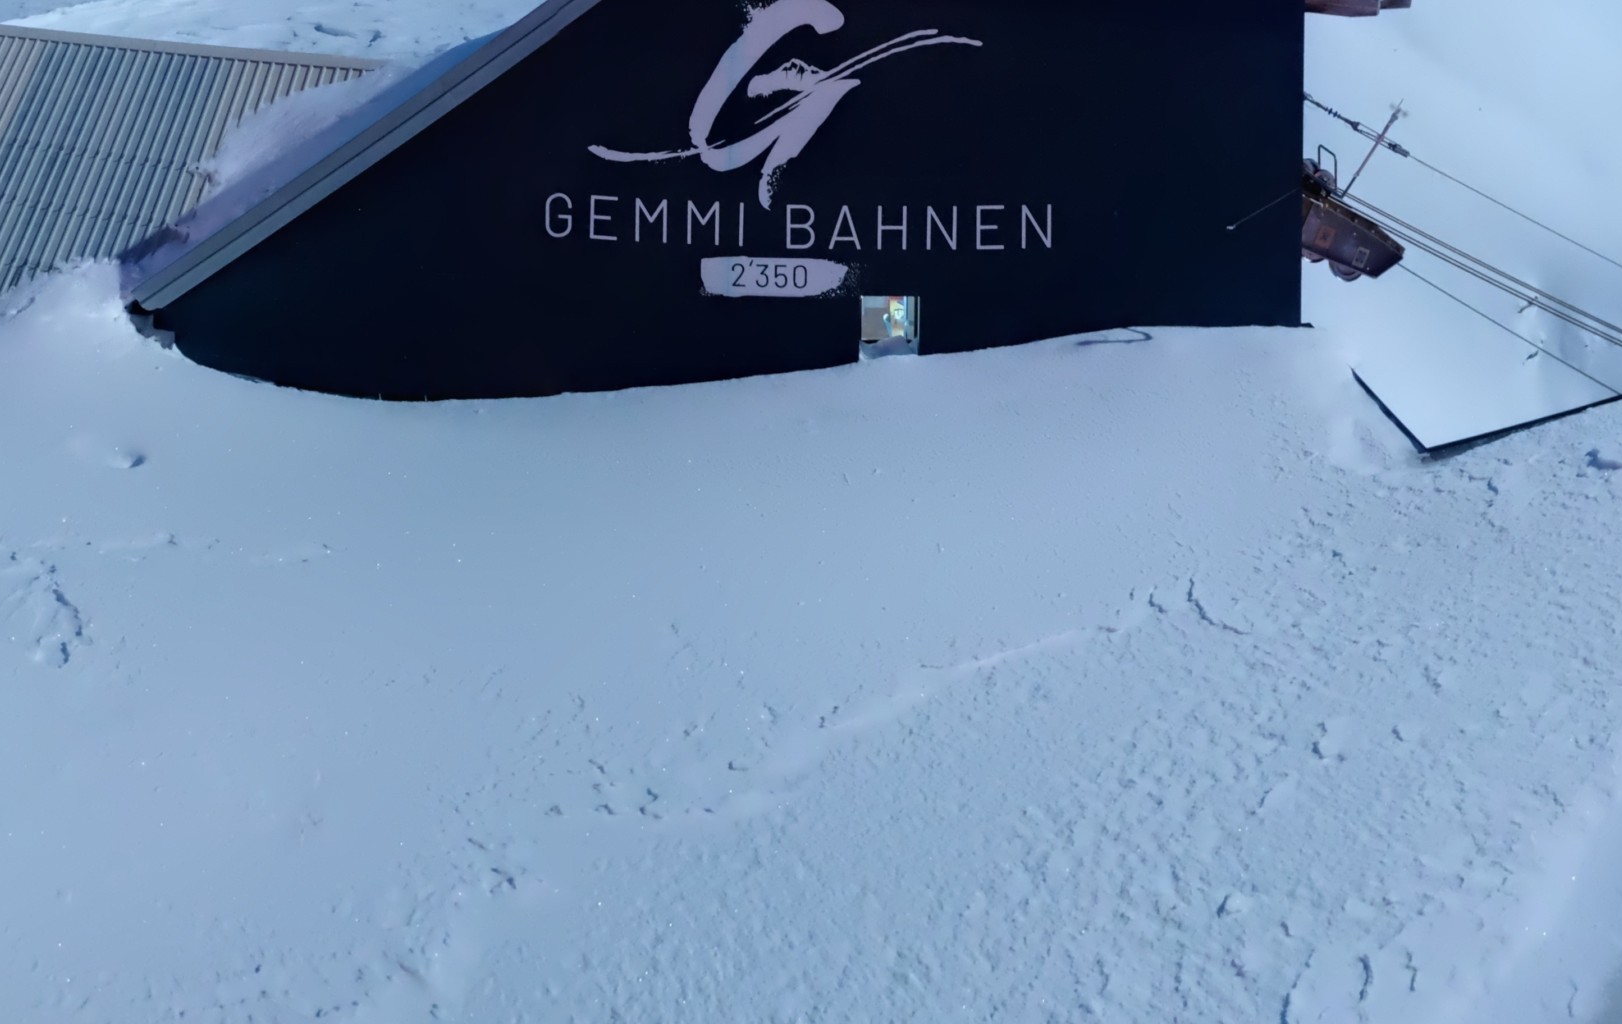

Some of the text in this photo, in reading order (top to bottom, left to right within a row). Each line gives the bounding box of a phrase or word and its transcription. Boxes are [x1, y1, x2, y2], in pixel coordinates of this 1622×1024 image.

[545, 192, 1052, 250] GEMMI BAHNEN
[731, 259, 808, 289] 2'350
